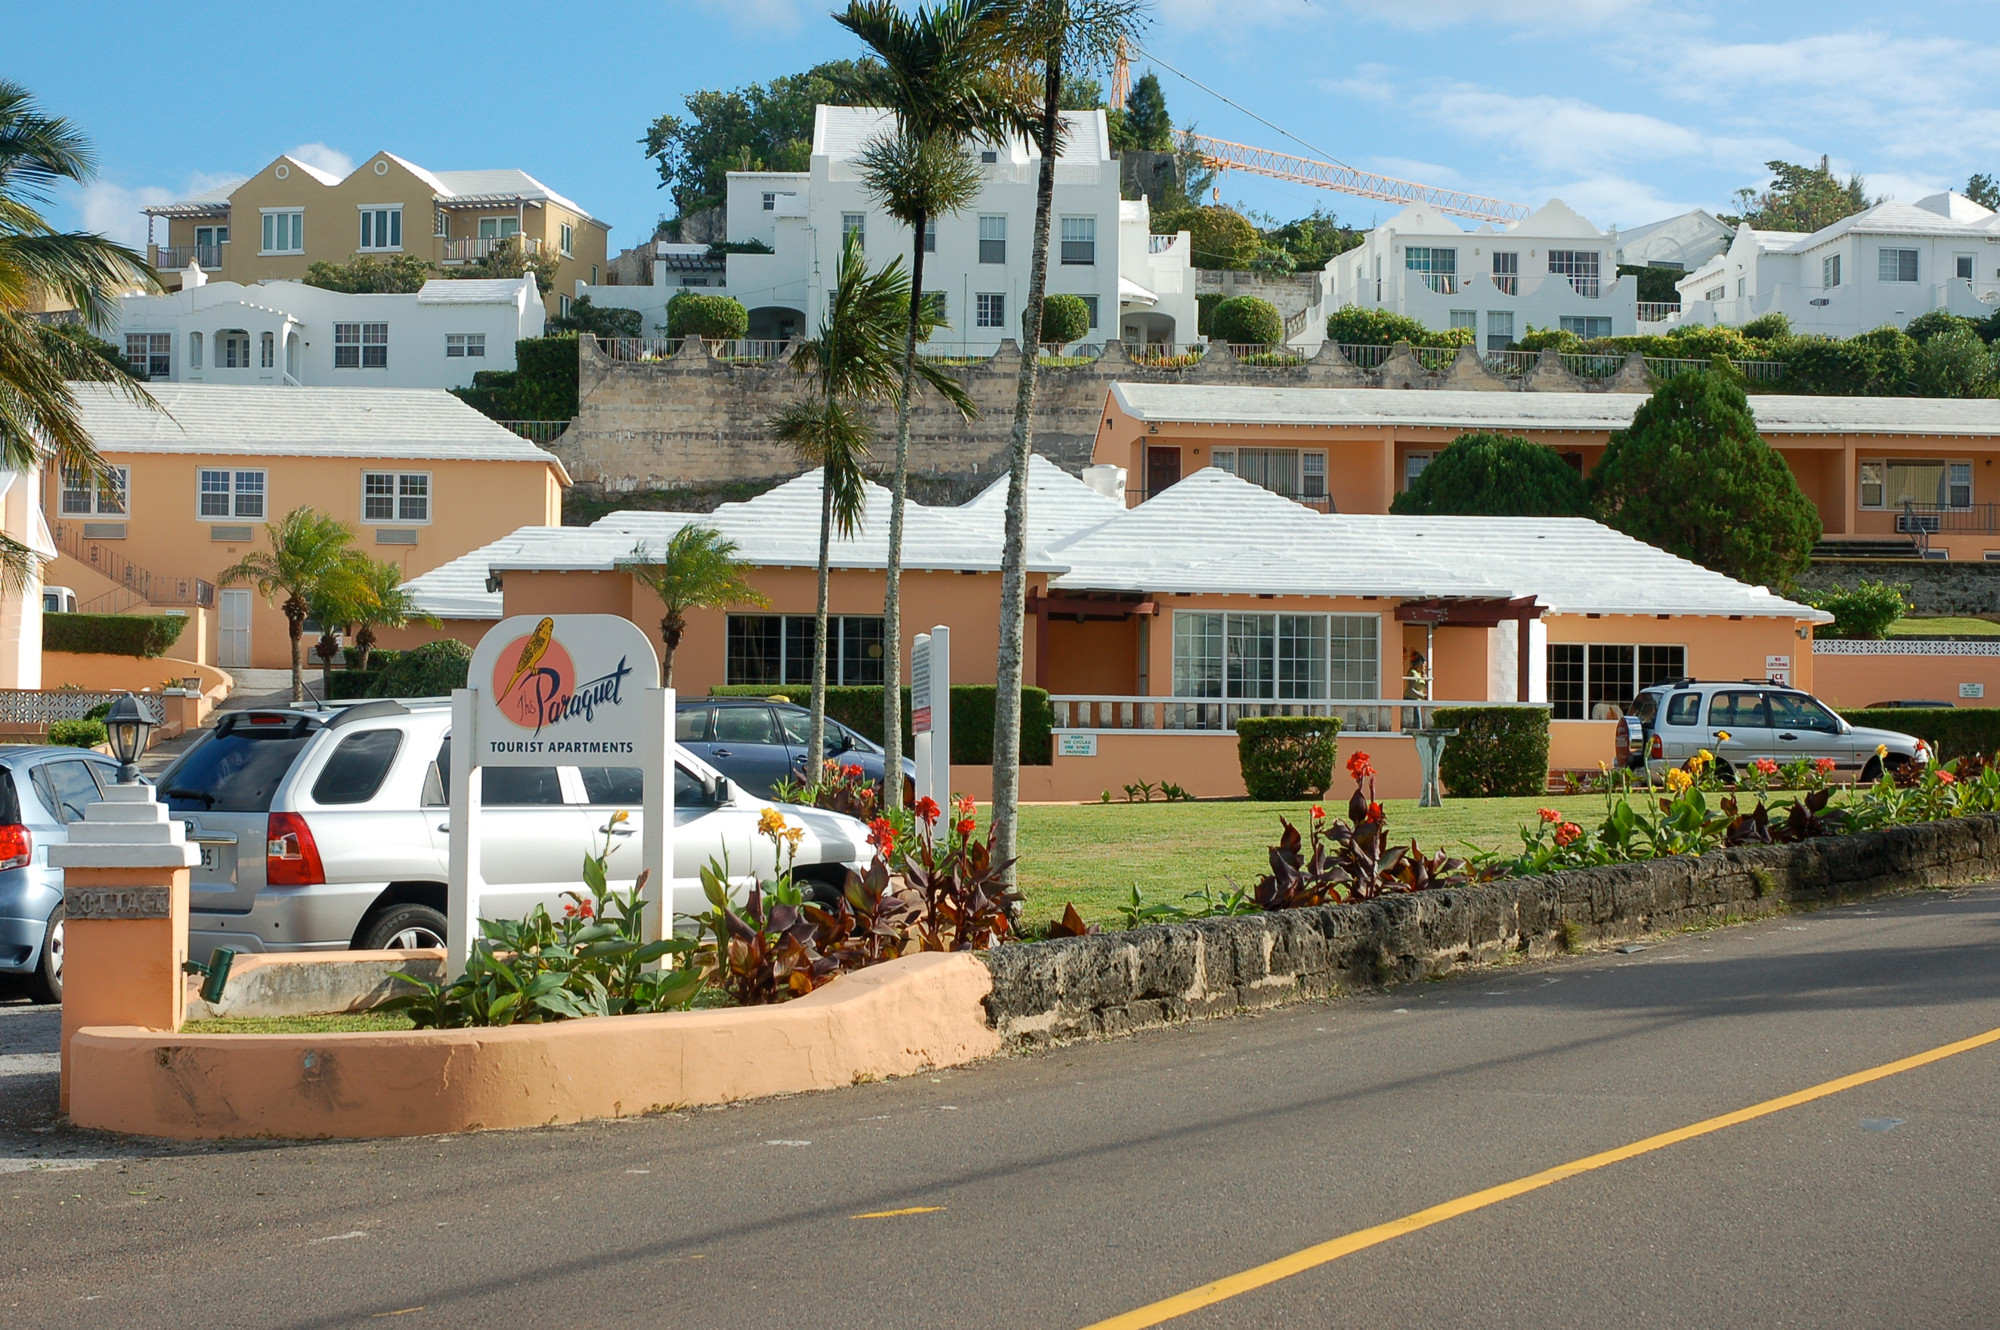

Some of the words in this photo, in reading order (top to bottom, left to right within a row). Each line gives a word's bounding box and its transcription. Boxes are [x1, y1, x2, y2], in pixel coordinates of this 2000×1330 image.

[517, 690, 537, 721] The
[518, 654, 633, 739] Paraquet
[490, 741, 544, 753] TOURIST
[548, 741, 634, 754] APARTMENTS
